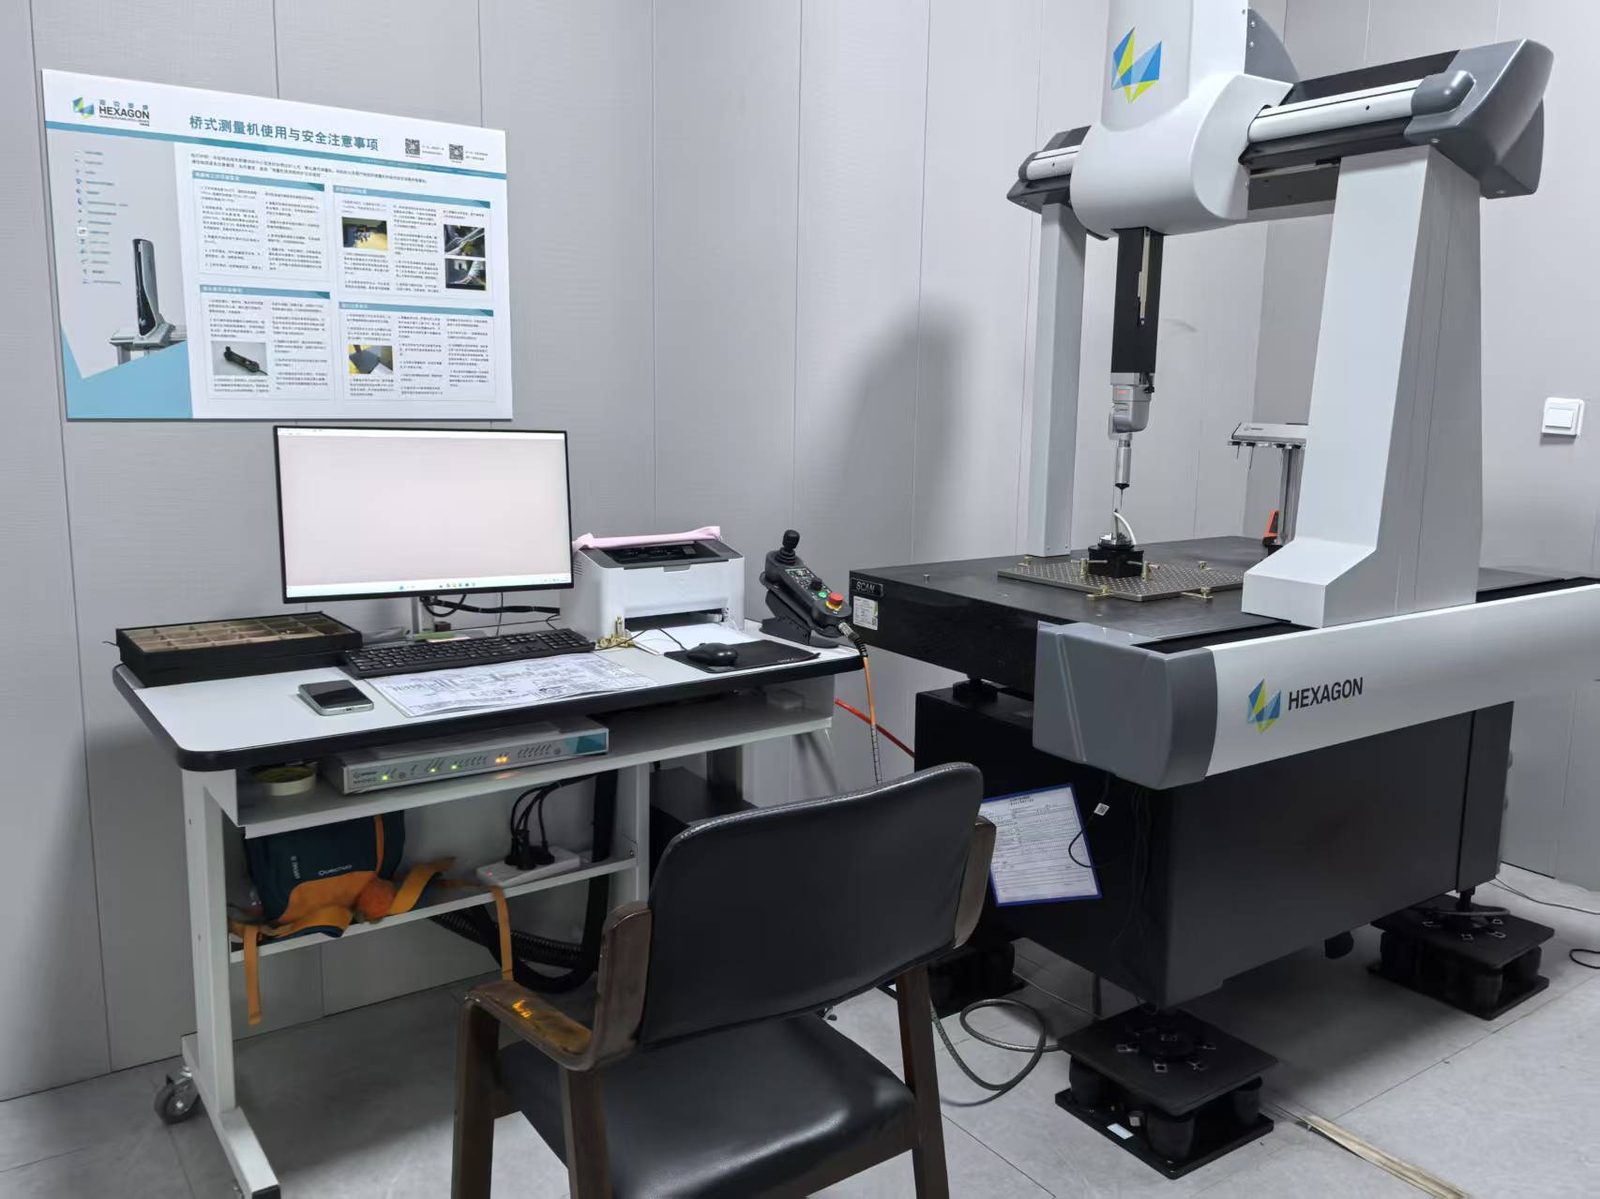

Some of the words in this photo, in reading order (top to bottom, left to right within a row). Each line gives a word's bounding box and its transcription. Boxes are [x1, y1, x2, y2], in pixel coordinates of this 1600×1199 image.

[99, 106, 150, 120] HEXAGON
[189, 115, 379, 151] 桥式测量机使用与安全注意事项
[856, 581, 875, 593] SCAN
[1288, 677, 1363, 711] HEXAGON
